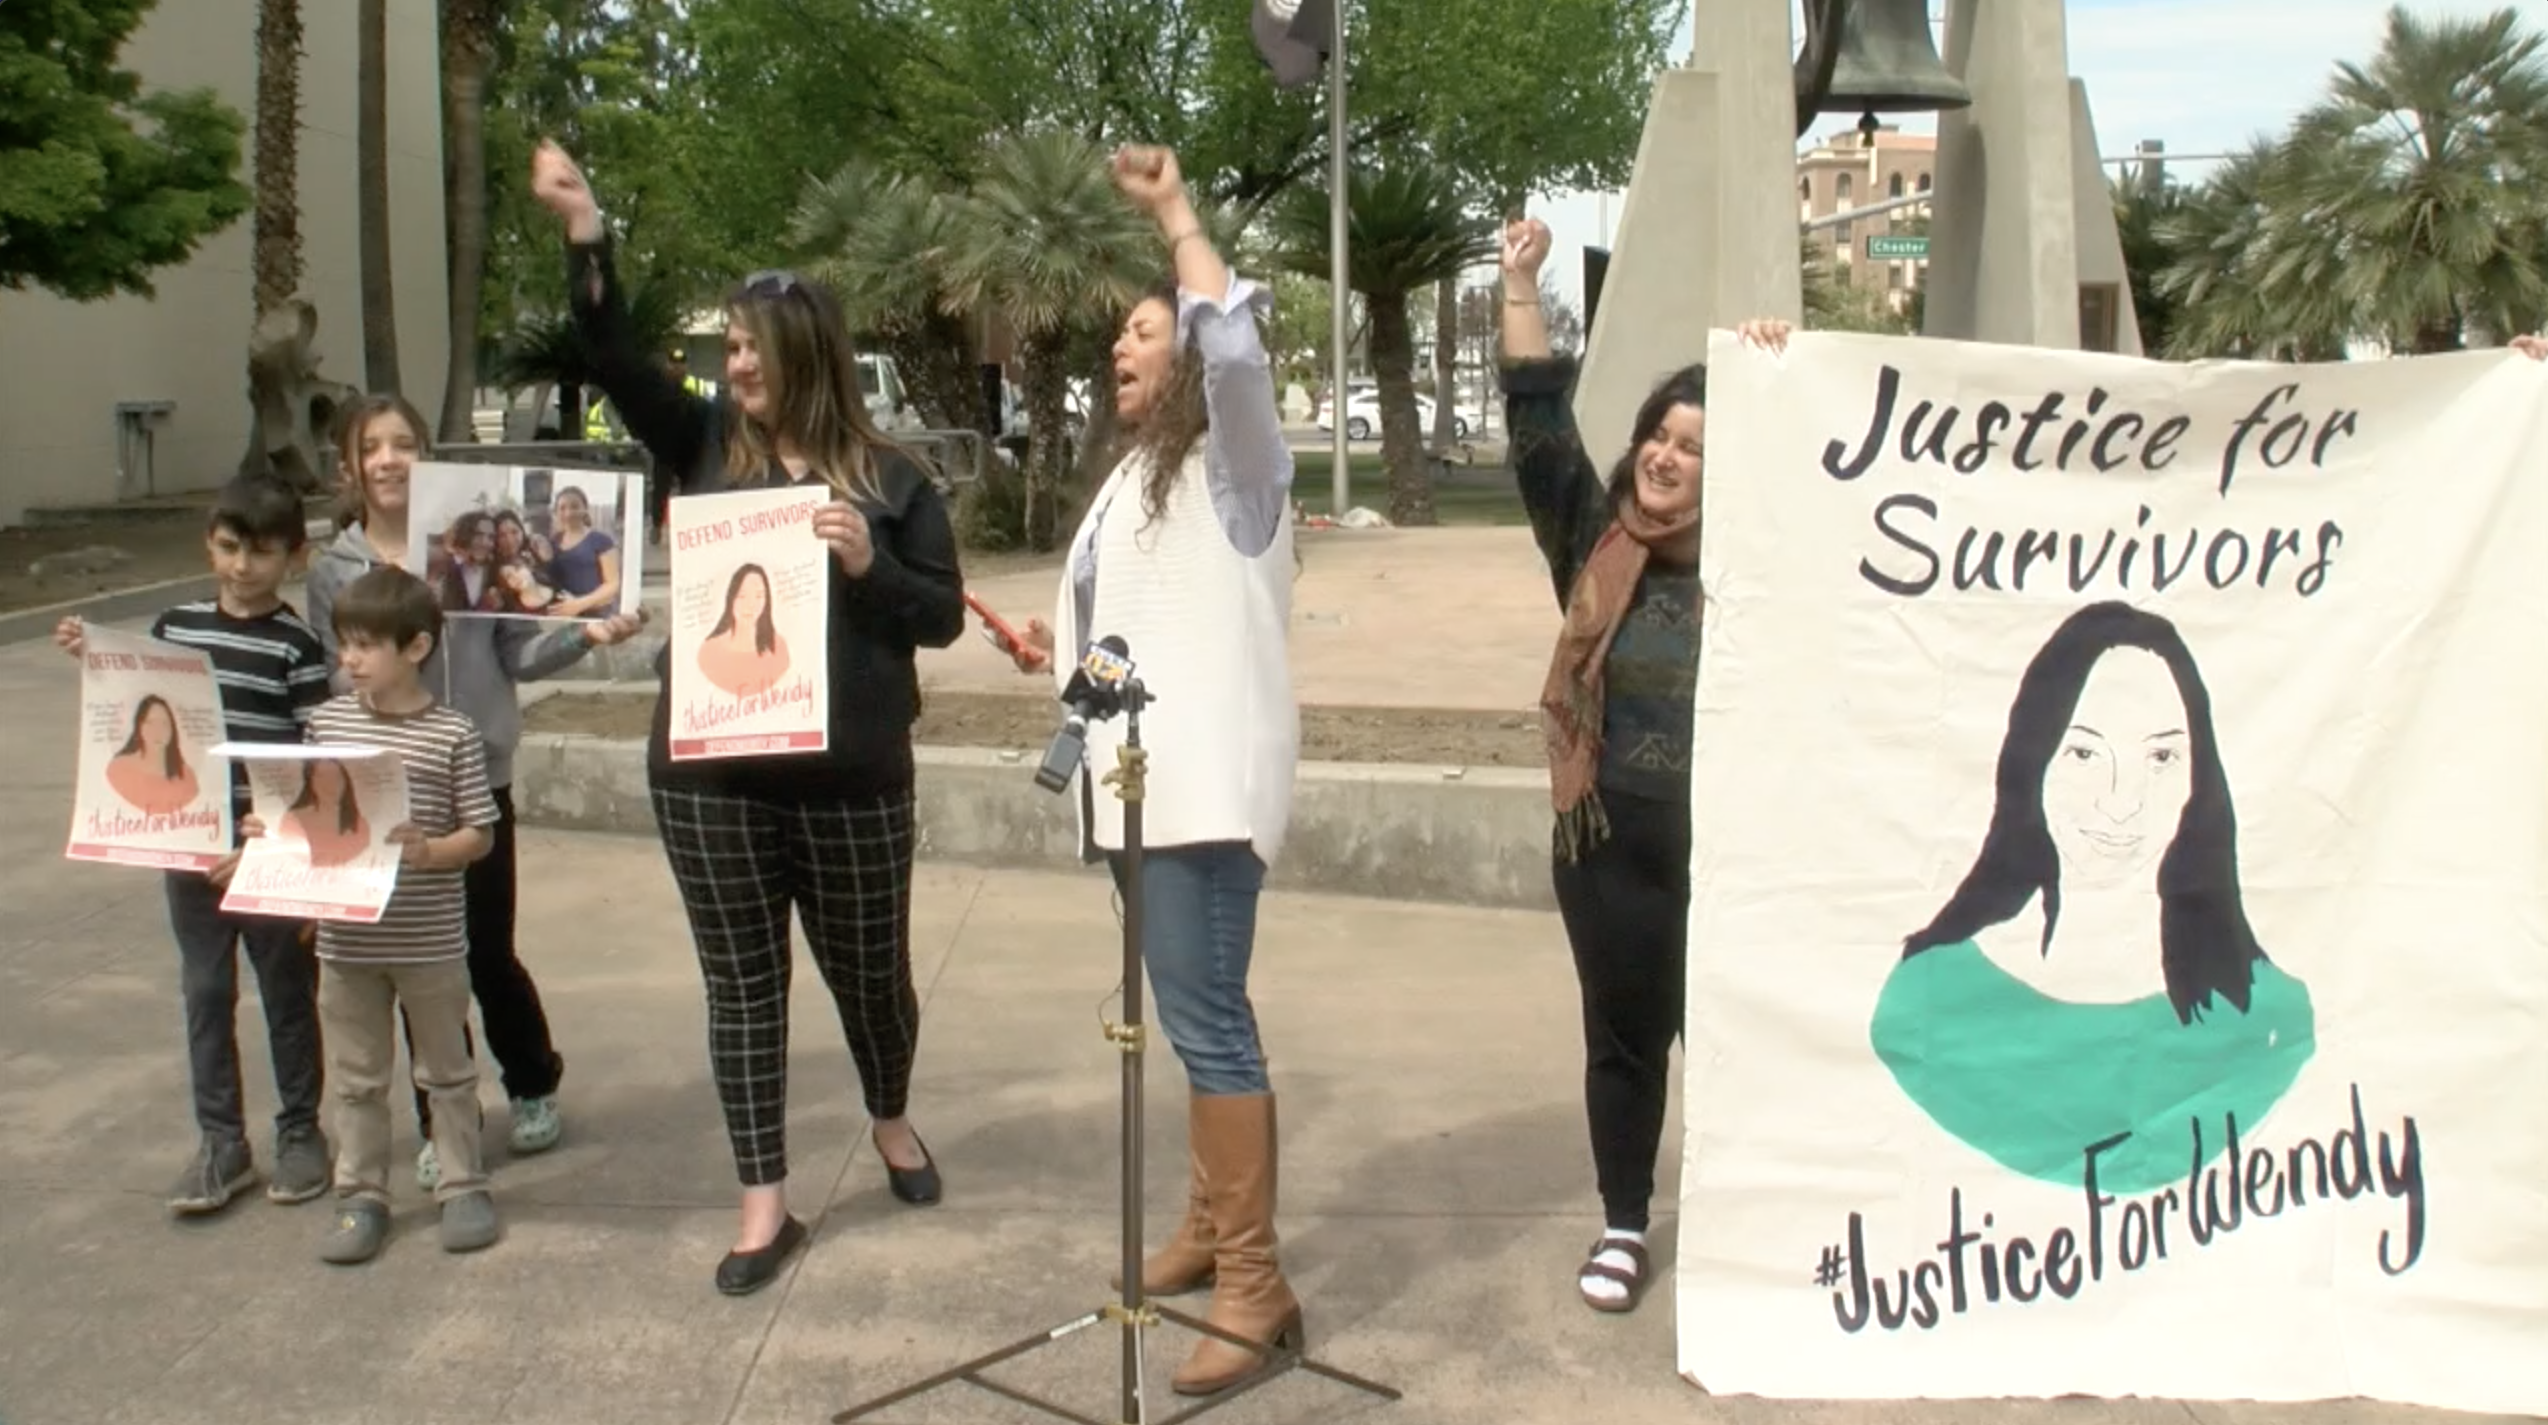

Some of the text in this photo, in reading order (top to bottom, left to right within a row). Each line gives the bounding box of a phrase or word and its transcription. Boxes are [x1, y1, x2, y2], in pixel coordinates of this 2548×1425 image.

[1873, 240, 1927, 254] Chester
[1822, 364, 2358, 498] Justice for
[676, 519, 733, 551] DEFEND
[1858, 493, 2343, 597] Survivors
[87, 652, 138, 671] DEFEND
[1813, 1082, 2426, 1334] #JusticeForWendy
